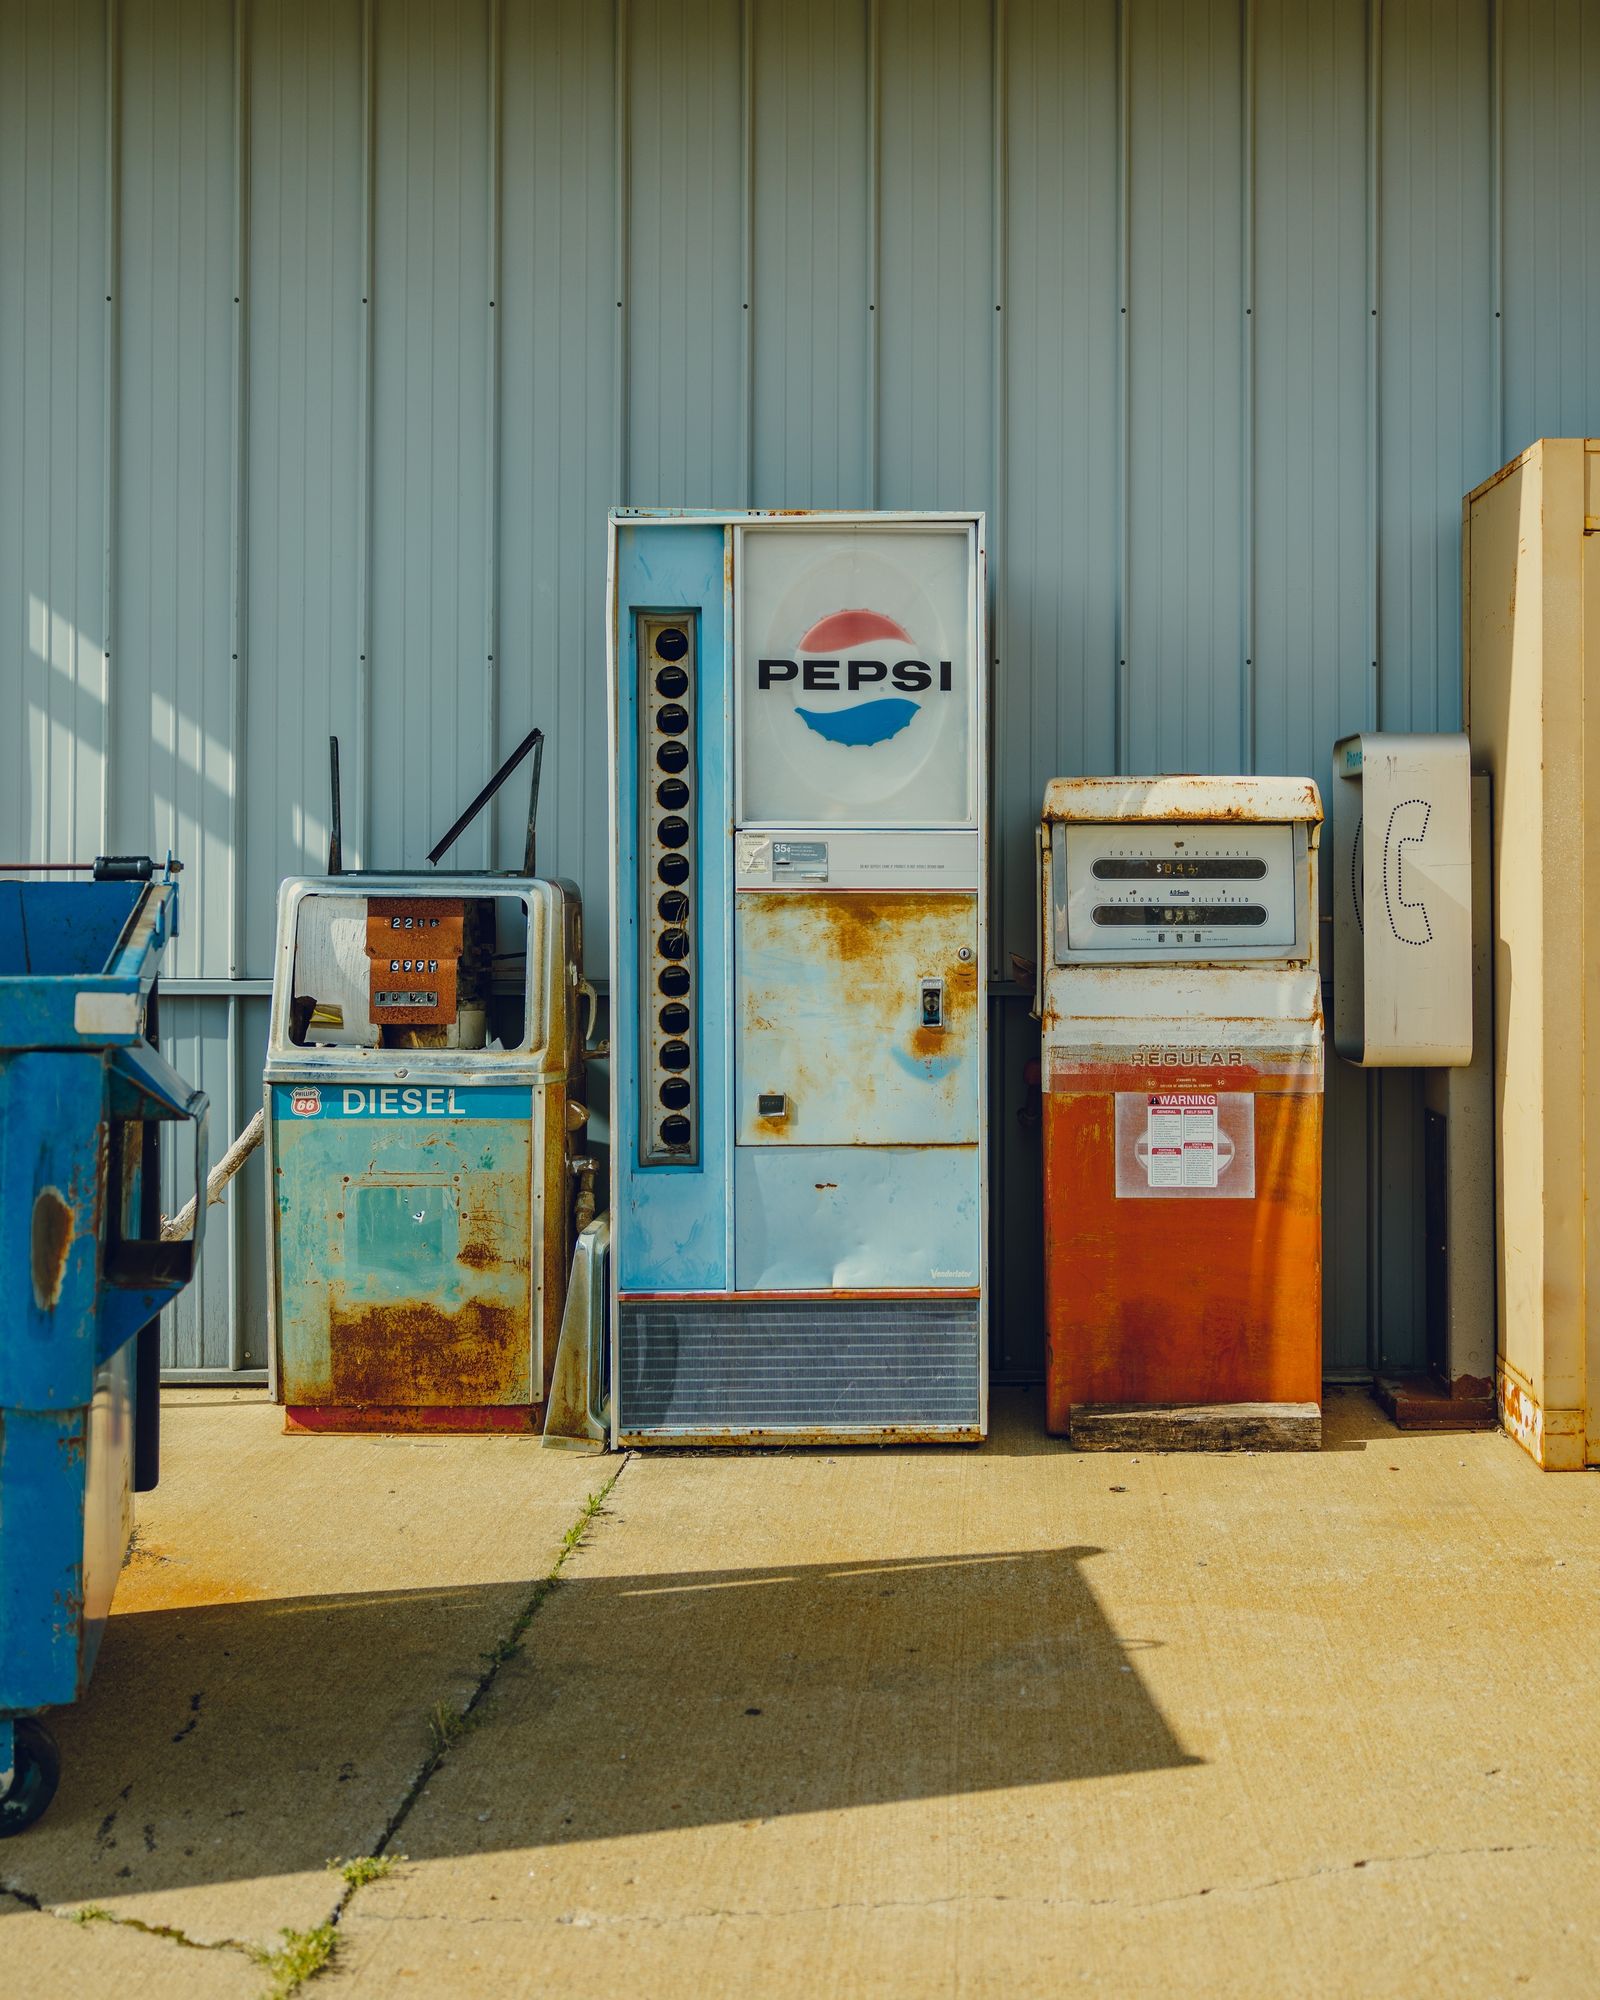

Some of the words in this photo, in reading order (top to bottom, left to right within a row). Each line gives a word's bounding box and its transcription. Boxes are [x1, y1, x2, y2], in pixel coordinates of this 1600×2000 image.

[758, 659, 952, 691] PEPSI
[1131, 1052, 1243, 1066] REGULAR
[296, 1100, 315, 1111] 66
[343, 1089, 466, 1115] DIESEL
[1159, 1095, 1216, 1105] WARNING
